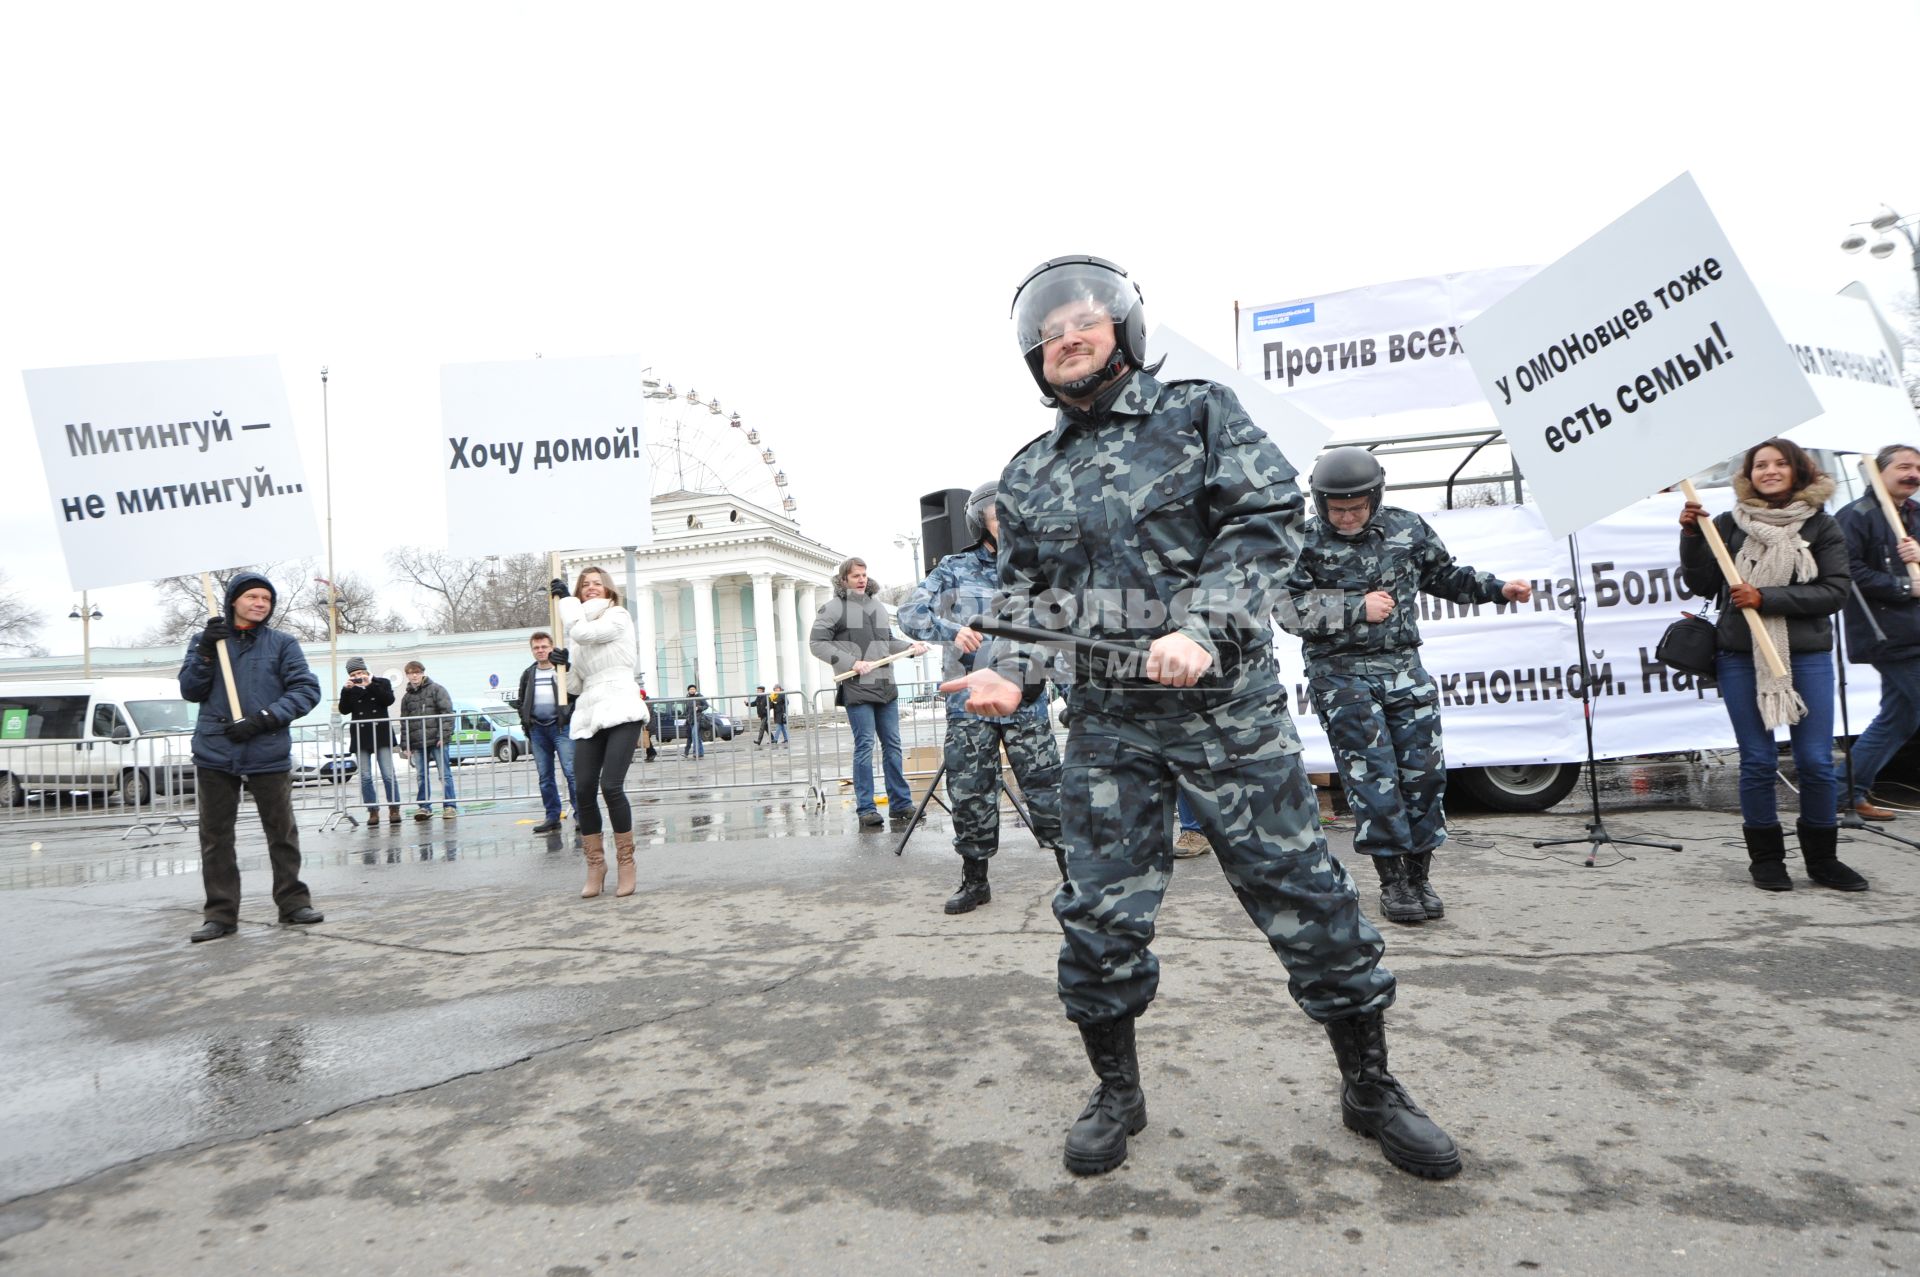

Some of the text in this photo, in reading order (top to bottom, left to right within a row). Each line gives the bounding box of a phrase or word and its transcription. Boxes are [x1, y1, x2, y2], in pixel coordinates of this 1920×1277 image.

[1263, 326, 1465, 387] Против всех
[1495, 257, 1723, 405] у ОМОНовцев тоже
[1544, 320, 1734, 452] есть семьи!
[65, 411, 233, 457] Митингуй
[449, 427, 640, 474] Хочу домой!
[61, 466, 303, 522] не митингуй...
[1531, 579, 1578, 612] на
